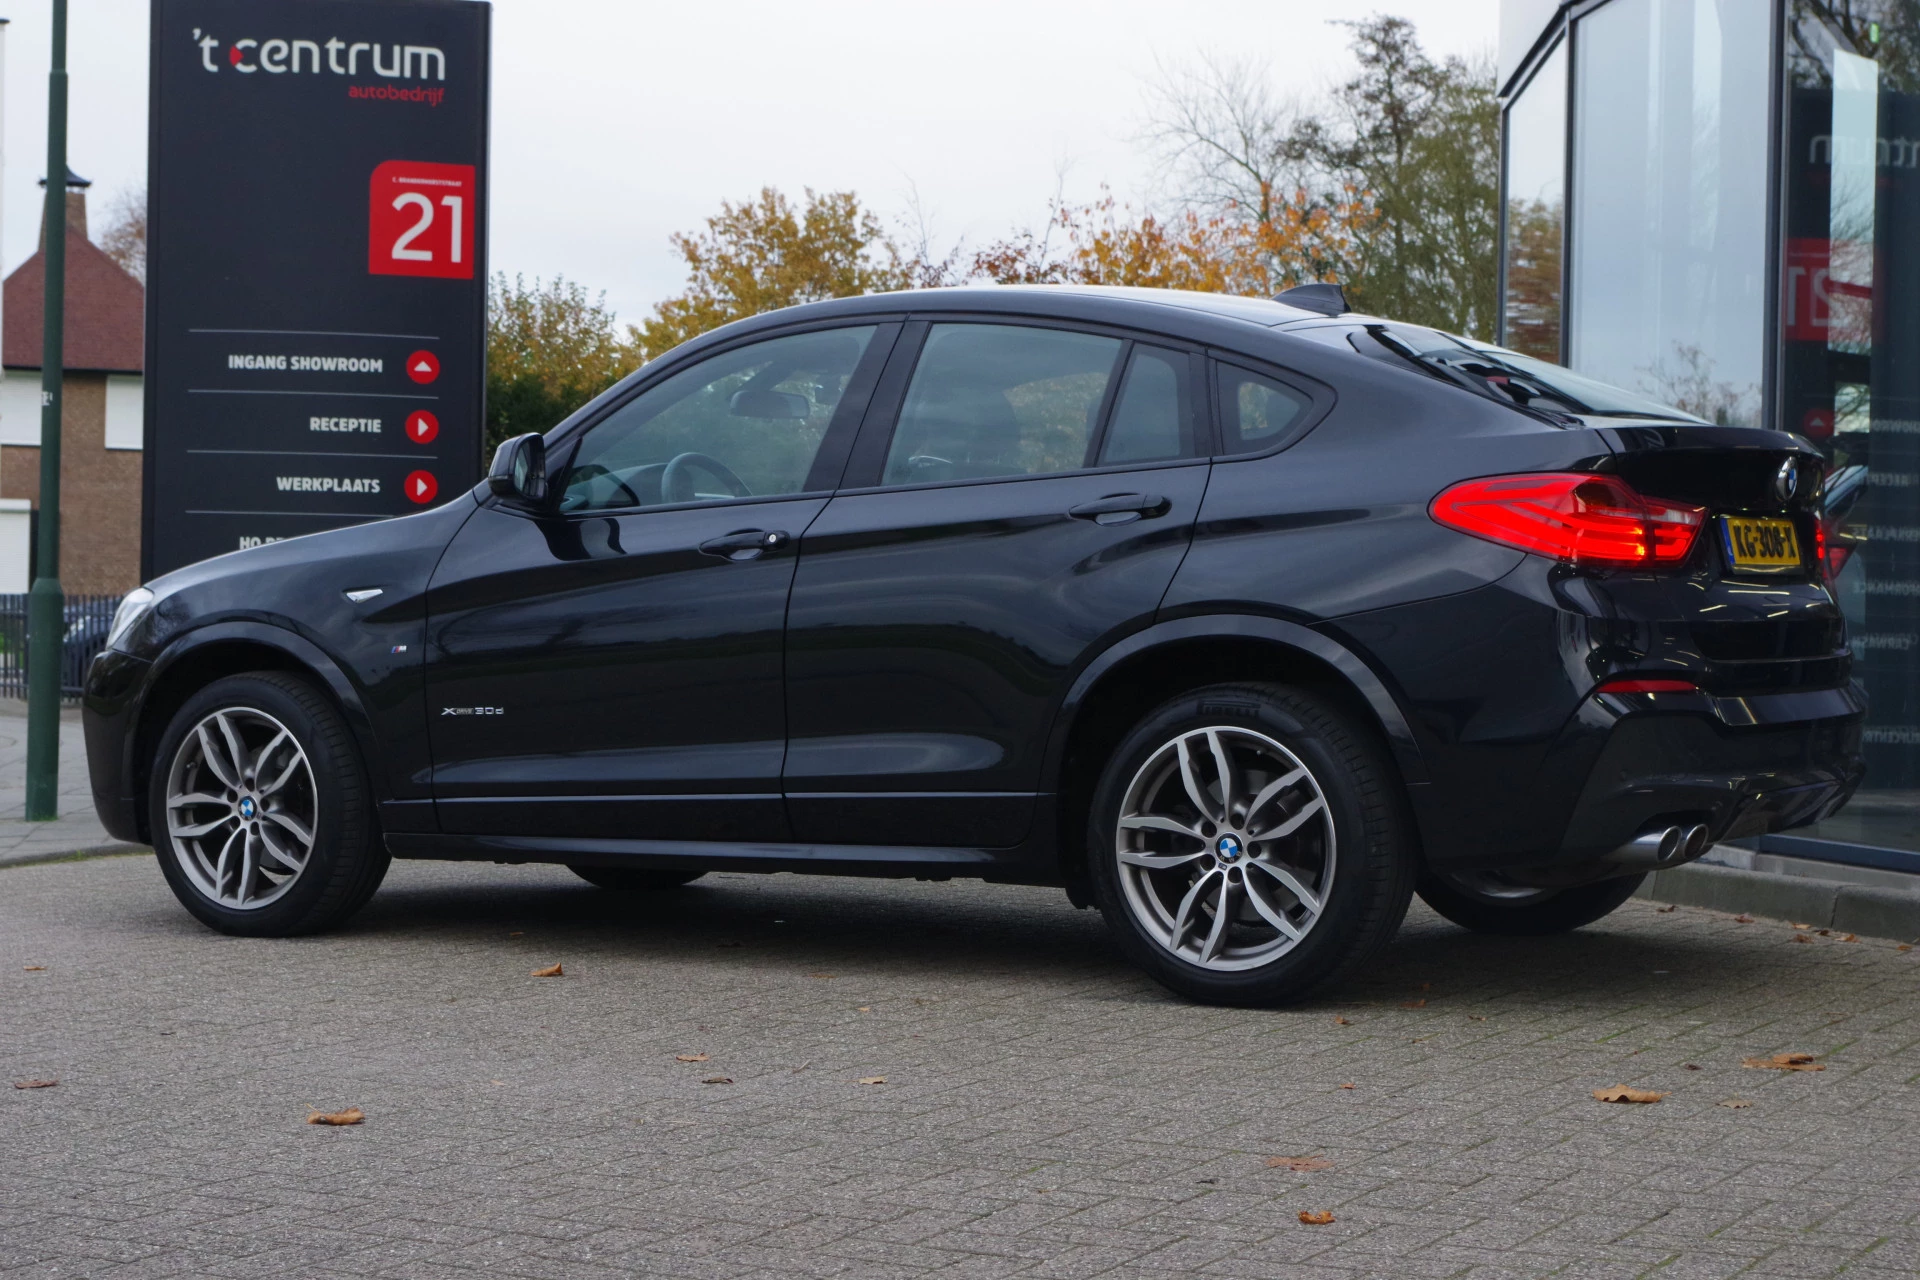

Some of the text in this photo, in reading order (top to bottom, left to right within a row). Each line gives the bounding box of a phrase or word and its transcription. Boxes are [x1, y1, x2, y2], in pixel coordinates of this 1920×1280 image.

[230, 36, 446, 80] centrum
[348, 84, 445, 107] autobedrijf
[391, 192, 463, 264] 21
[228, 354, 383, 373] INGANG SHOWROOM
[309, 416, 382, 433] RECEPTIE
[276, 476, 381, 494] WERKPLAATS
